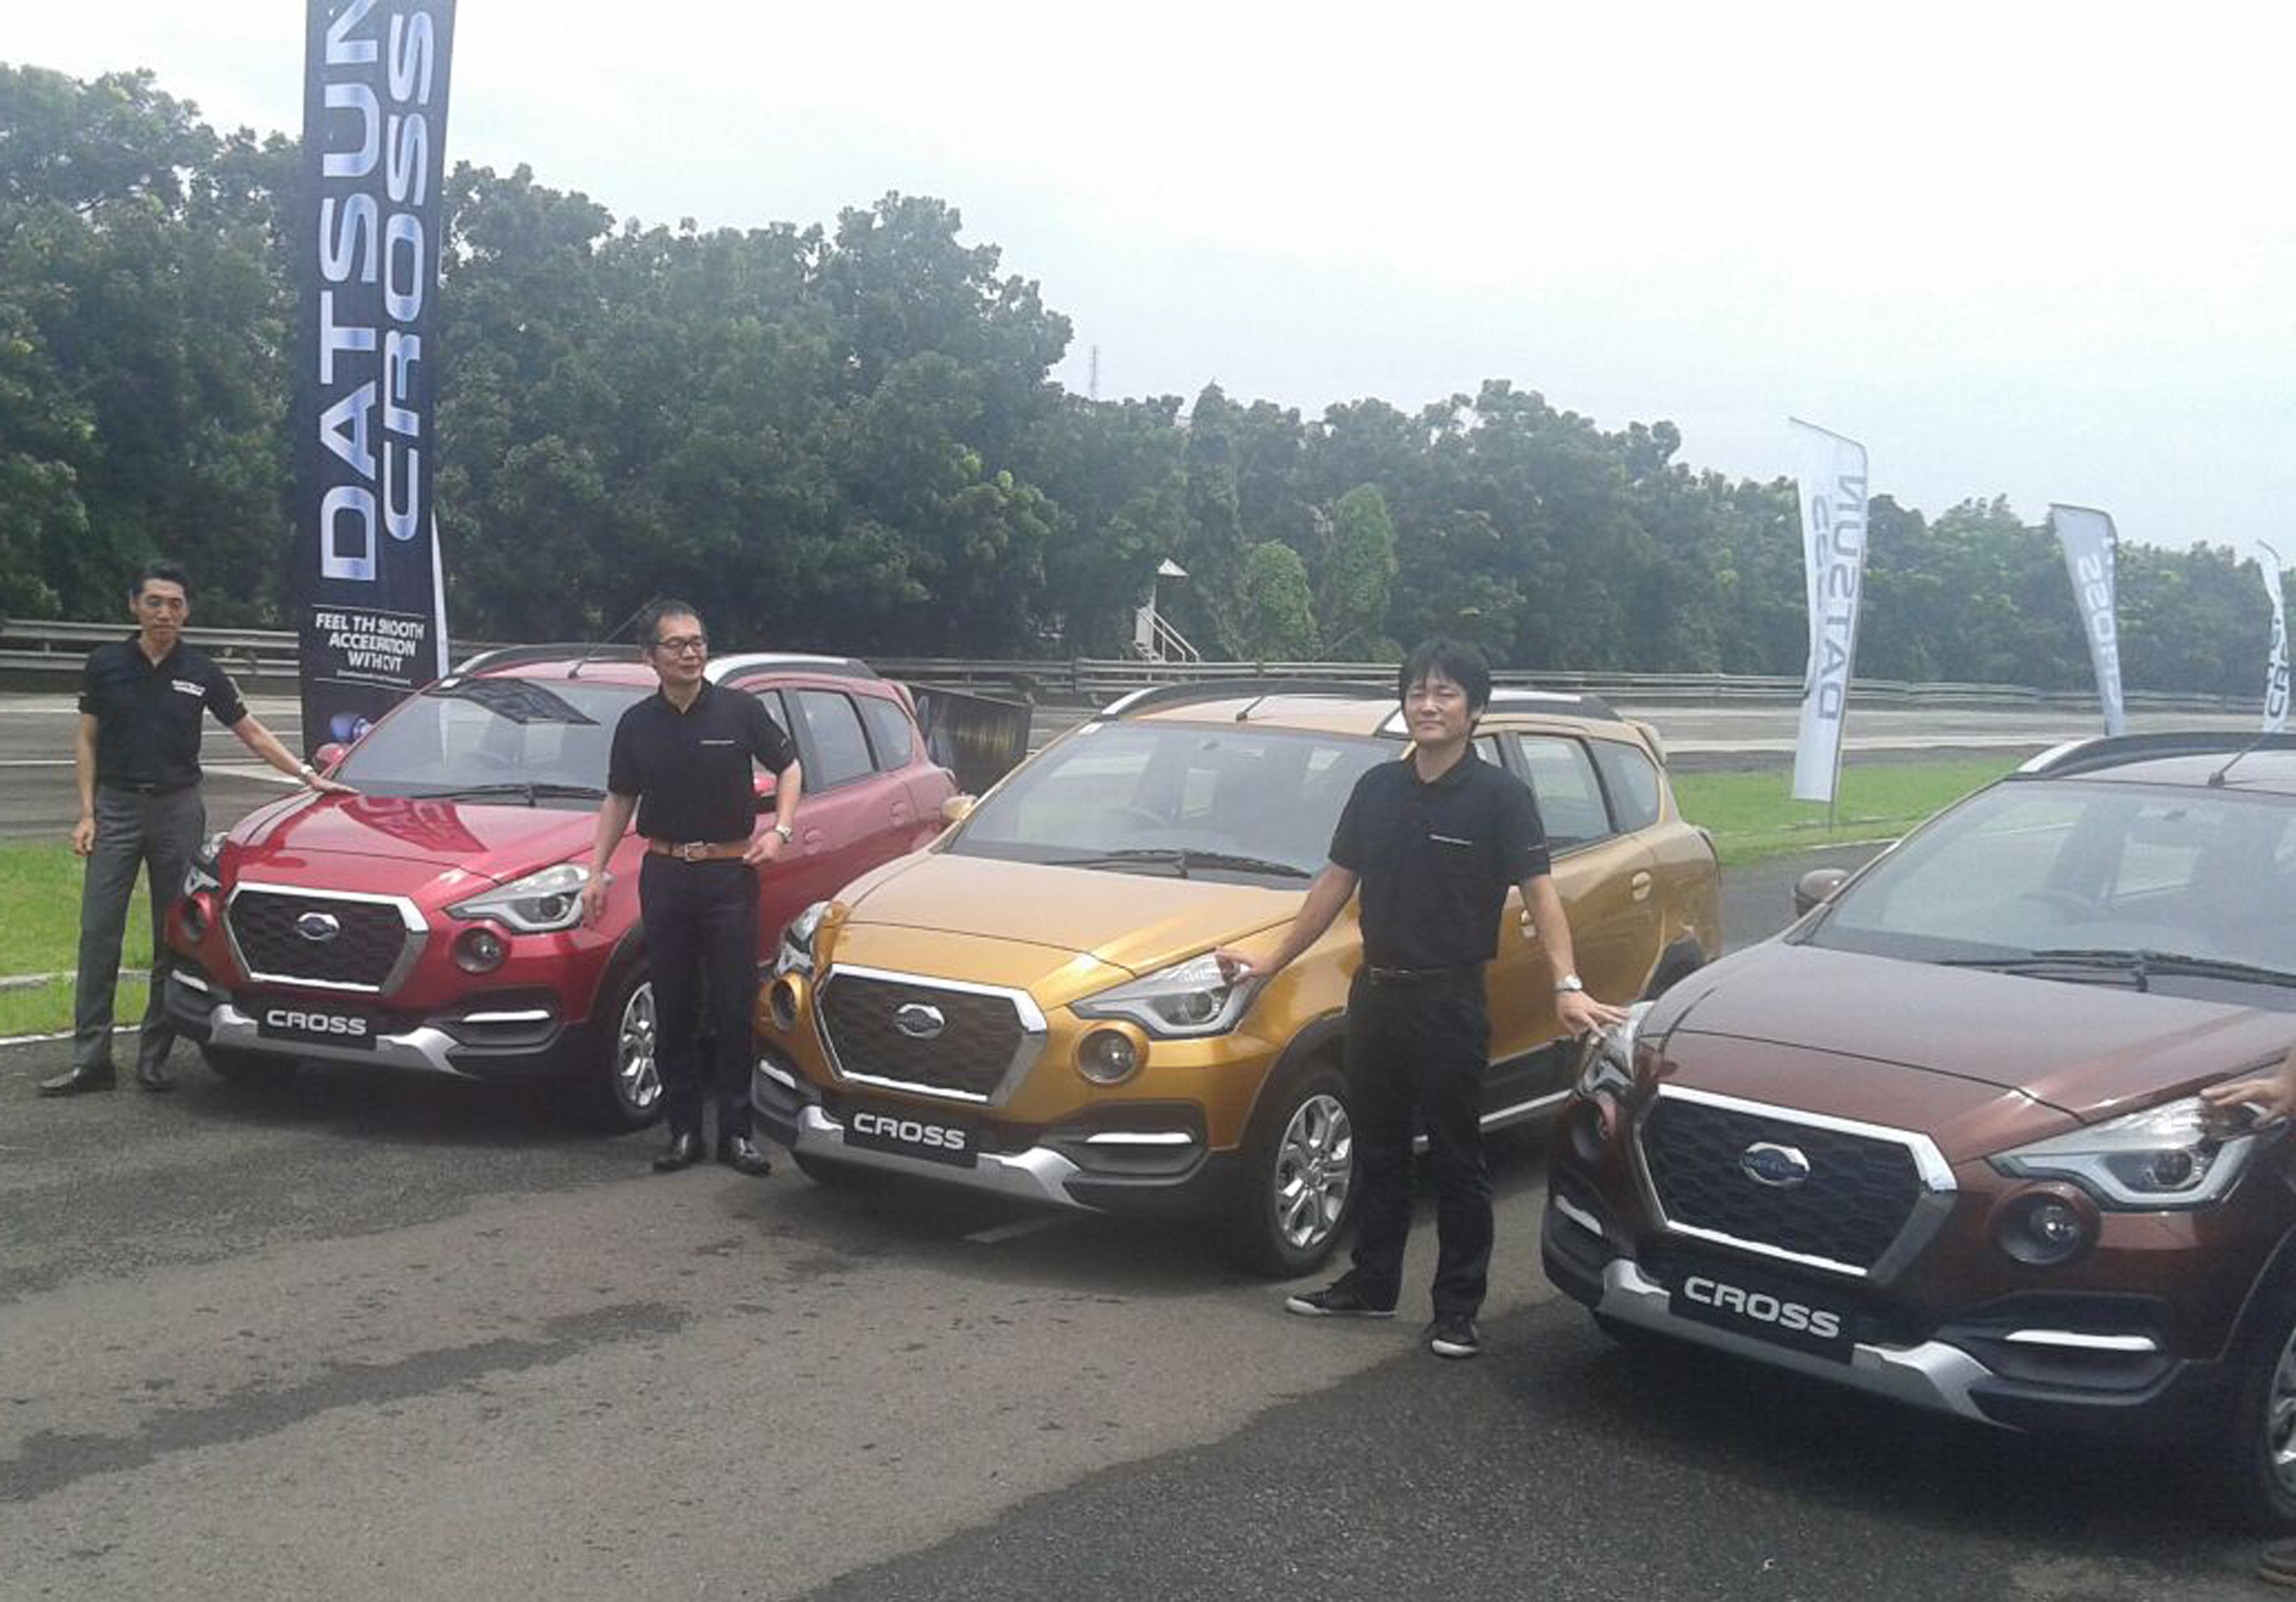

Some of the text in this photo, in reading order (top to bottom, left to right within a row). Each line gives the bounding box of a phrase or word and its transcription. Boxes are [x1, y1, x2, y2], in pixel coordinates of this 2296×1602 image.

[319, 0, 380, 581] DATSUN
[383, 11, 434, 541] CROSS
[316, 613, 349, 630] FEEL
[378, 619, 425, 640] SOOTH
[267, 1010, 367, 1036] CROSS
[853, 1113, 966, 1150] CROSS
[1684, 1276, 1841, 1339] CROSS
